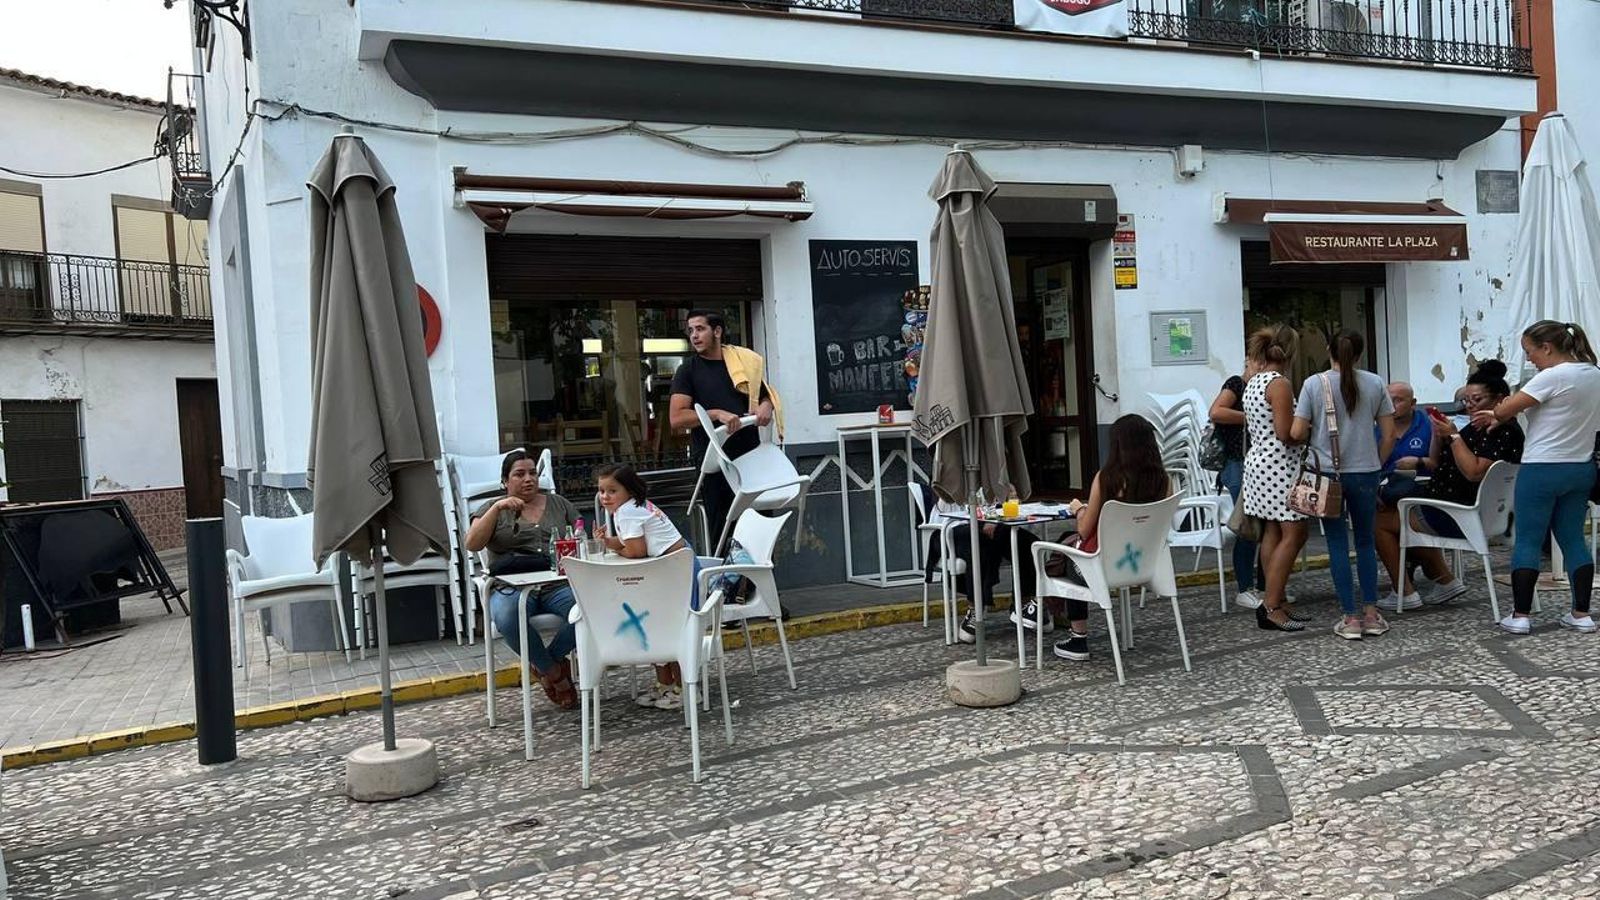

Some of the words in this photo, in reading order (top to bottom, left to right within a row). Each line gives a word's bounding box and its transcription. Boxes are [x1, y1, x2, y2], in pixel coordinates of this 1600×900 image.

[1305, 236, 1384, 248] RESTAURANTE
[1387, 236, 1403, 248] LA
[1404, 236, 1439, 248] PLAZA
[853, 335, 892, 361] BAR
